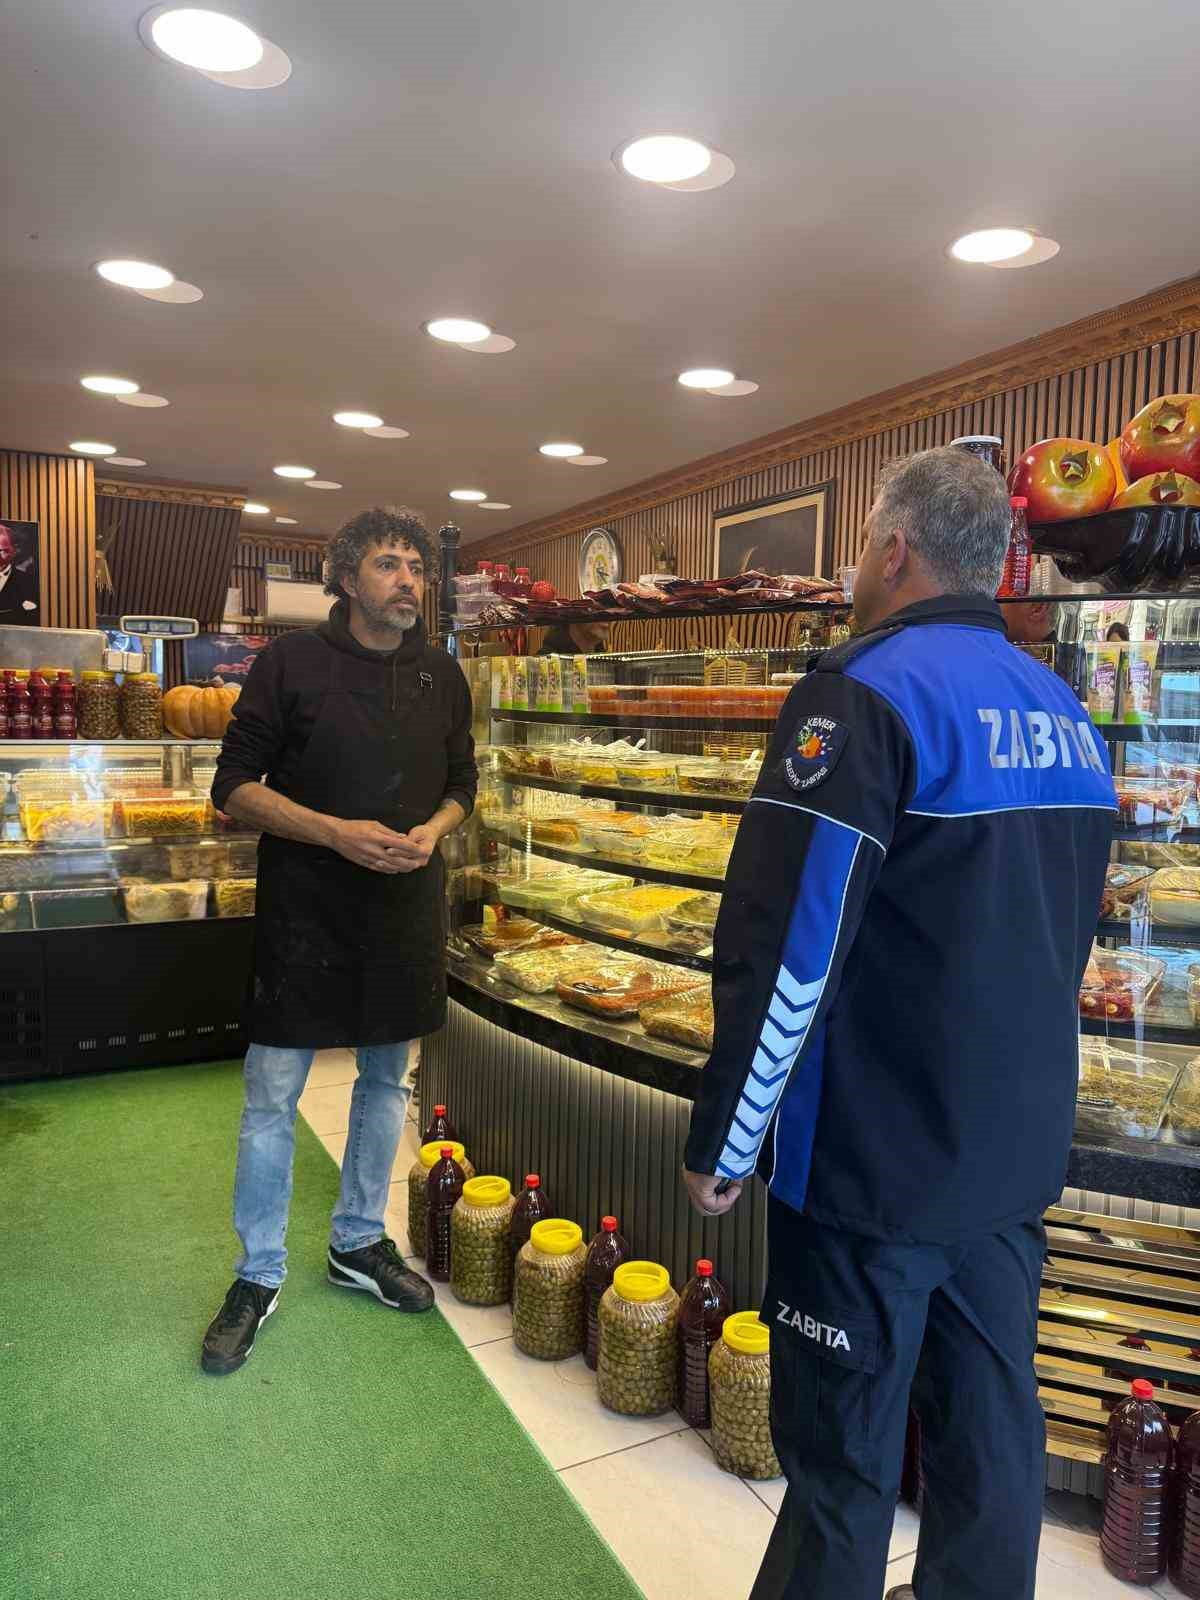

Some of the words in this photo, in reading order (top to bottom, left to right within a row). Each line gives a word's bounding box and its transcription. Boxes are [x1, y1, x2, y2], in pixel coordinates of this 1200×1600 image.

[806, 717, 837, 731] KEMER
[977, 708, 1106, 775] ZABITA
[776, 1300, 851, 1351] ZABITA
